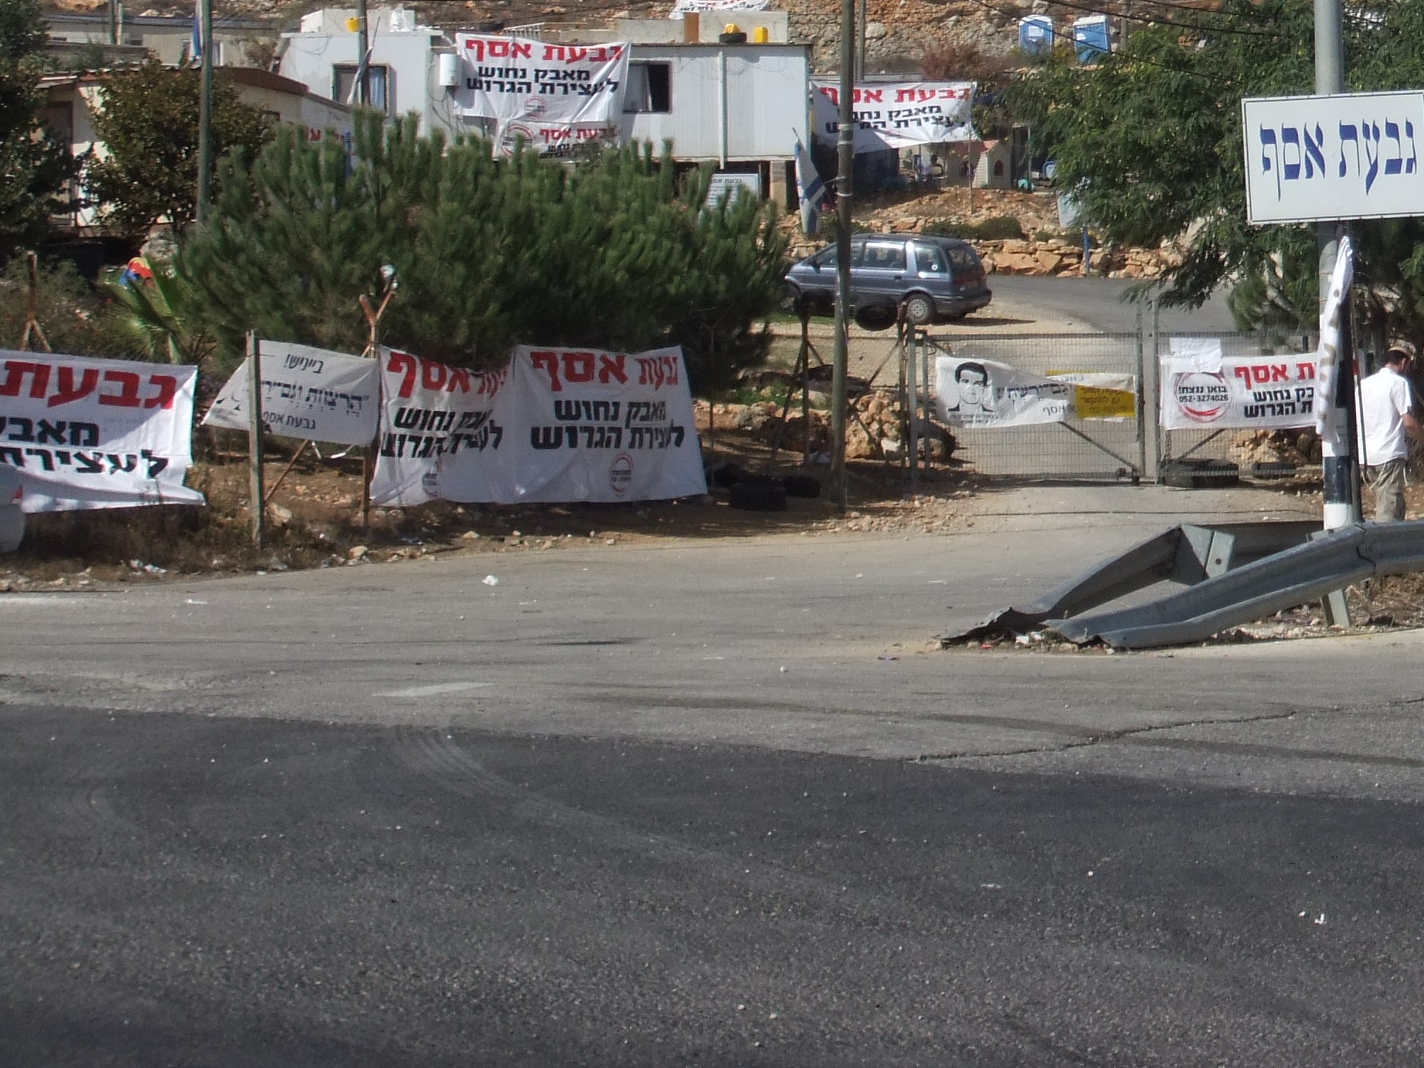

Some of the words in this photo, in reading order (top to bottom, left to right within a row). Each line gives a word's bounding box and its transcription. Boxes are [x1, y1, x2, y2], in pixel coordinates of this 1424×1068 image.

[465, 39, 532, 62] אסף
[478, 66, 527, 79] נחוש
[534, 68, 591, 83] מאבק
[466, 78, 532, 93] הגרוש
[895, 87, 972, 103] גבעת
[887, 104, 942, 121] מאבק
[1260, 121, 1326, 202] אסף
[1338, 117, 1417, 197] גבעת
[386, 351, 472, 399] אסף
[529, 350, 628, 392] אסף
[1233, 363, 1290, 390] אסף
[0, 360, 178, 410] גבעת
[1178, 385, 1203, 395] ננצח!
[1206, 384, 1227, 394] בואו
[1178, 394, 1229, 403] 052-3274026
[1253, 388, 1292, 402] נחוש
[394, 406, 456, 431] נחוש
[554, 399, 621, 421] נחוש
[1244, 402, 1296, 419] הגרוש
[0, 416, 100, 448] מאב
[286, 415, 317, 430] גבעת
[530, 425, 623, 451] הגרוש
